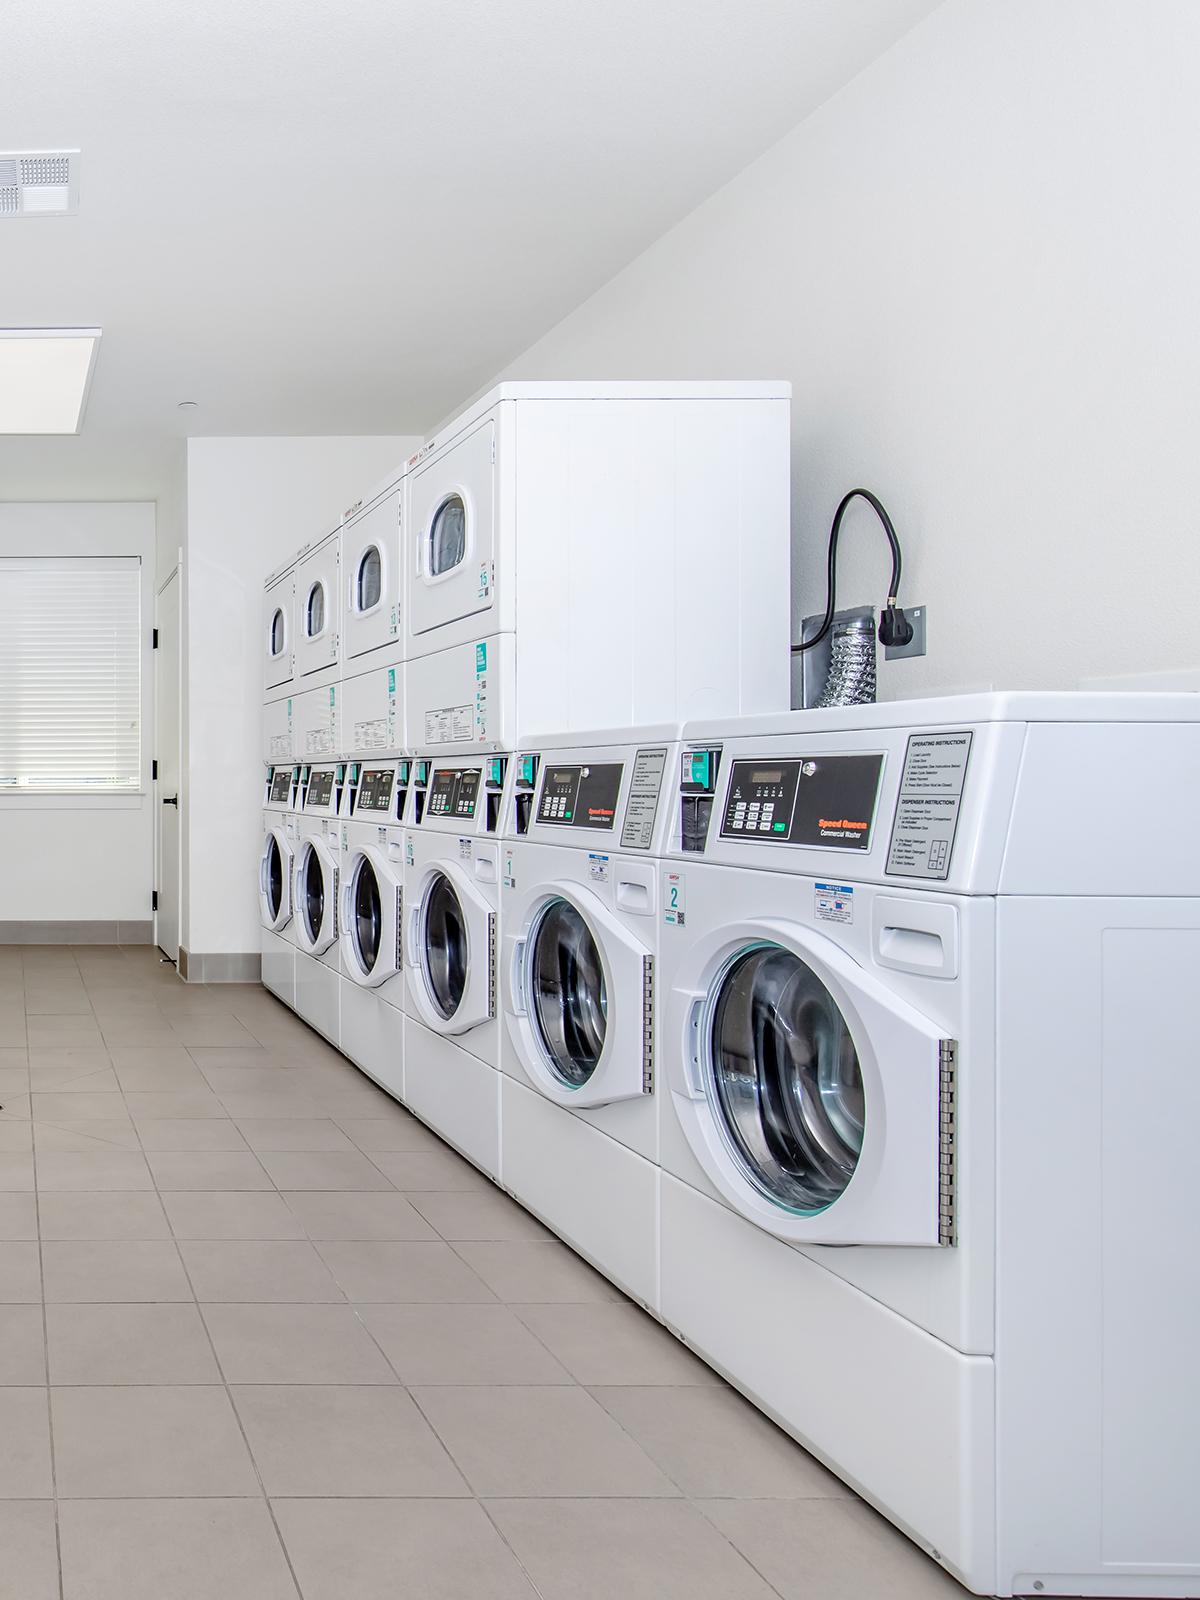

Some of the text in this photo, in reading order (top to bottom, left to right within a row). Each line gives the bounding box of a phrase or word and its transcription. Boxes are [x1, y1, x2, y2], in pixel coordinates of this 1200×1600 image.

[818, 819, 867, 829] Speed Queen
[821, 829, 844, 837] Commercial
[507, 860, 511, 875] 1
[671, 888, 678, 907] 2
